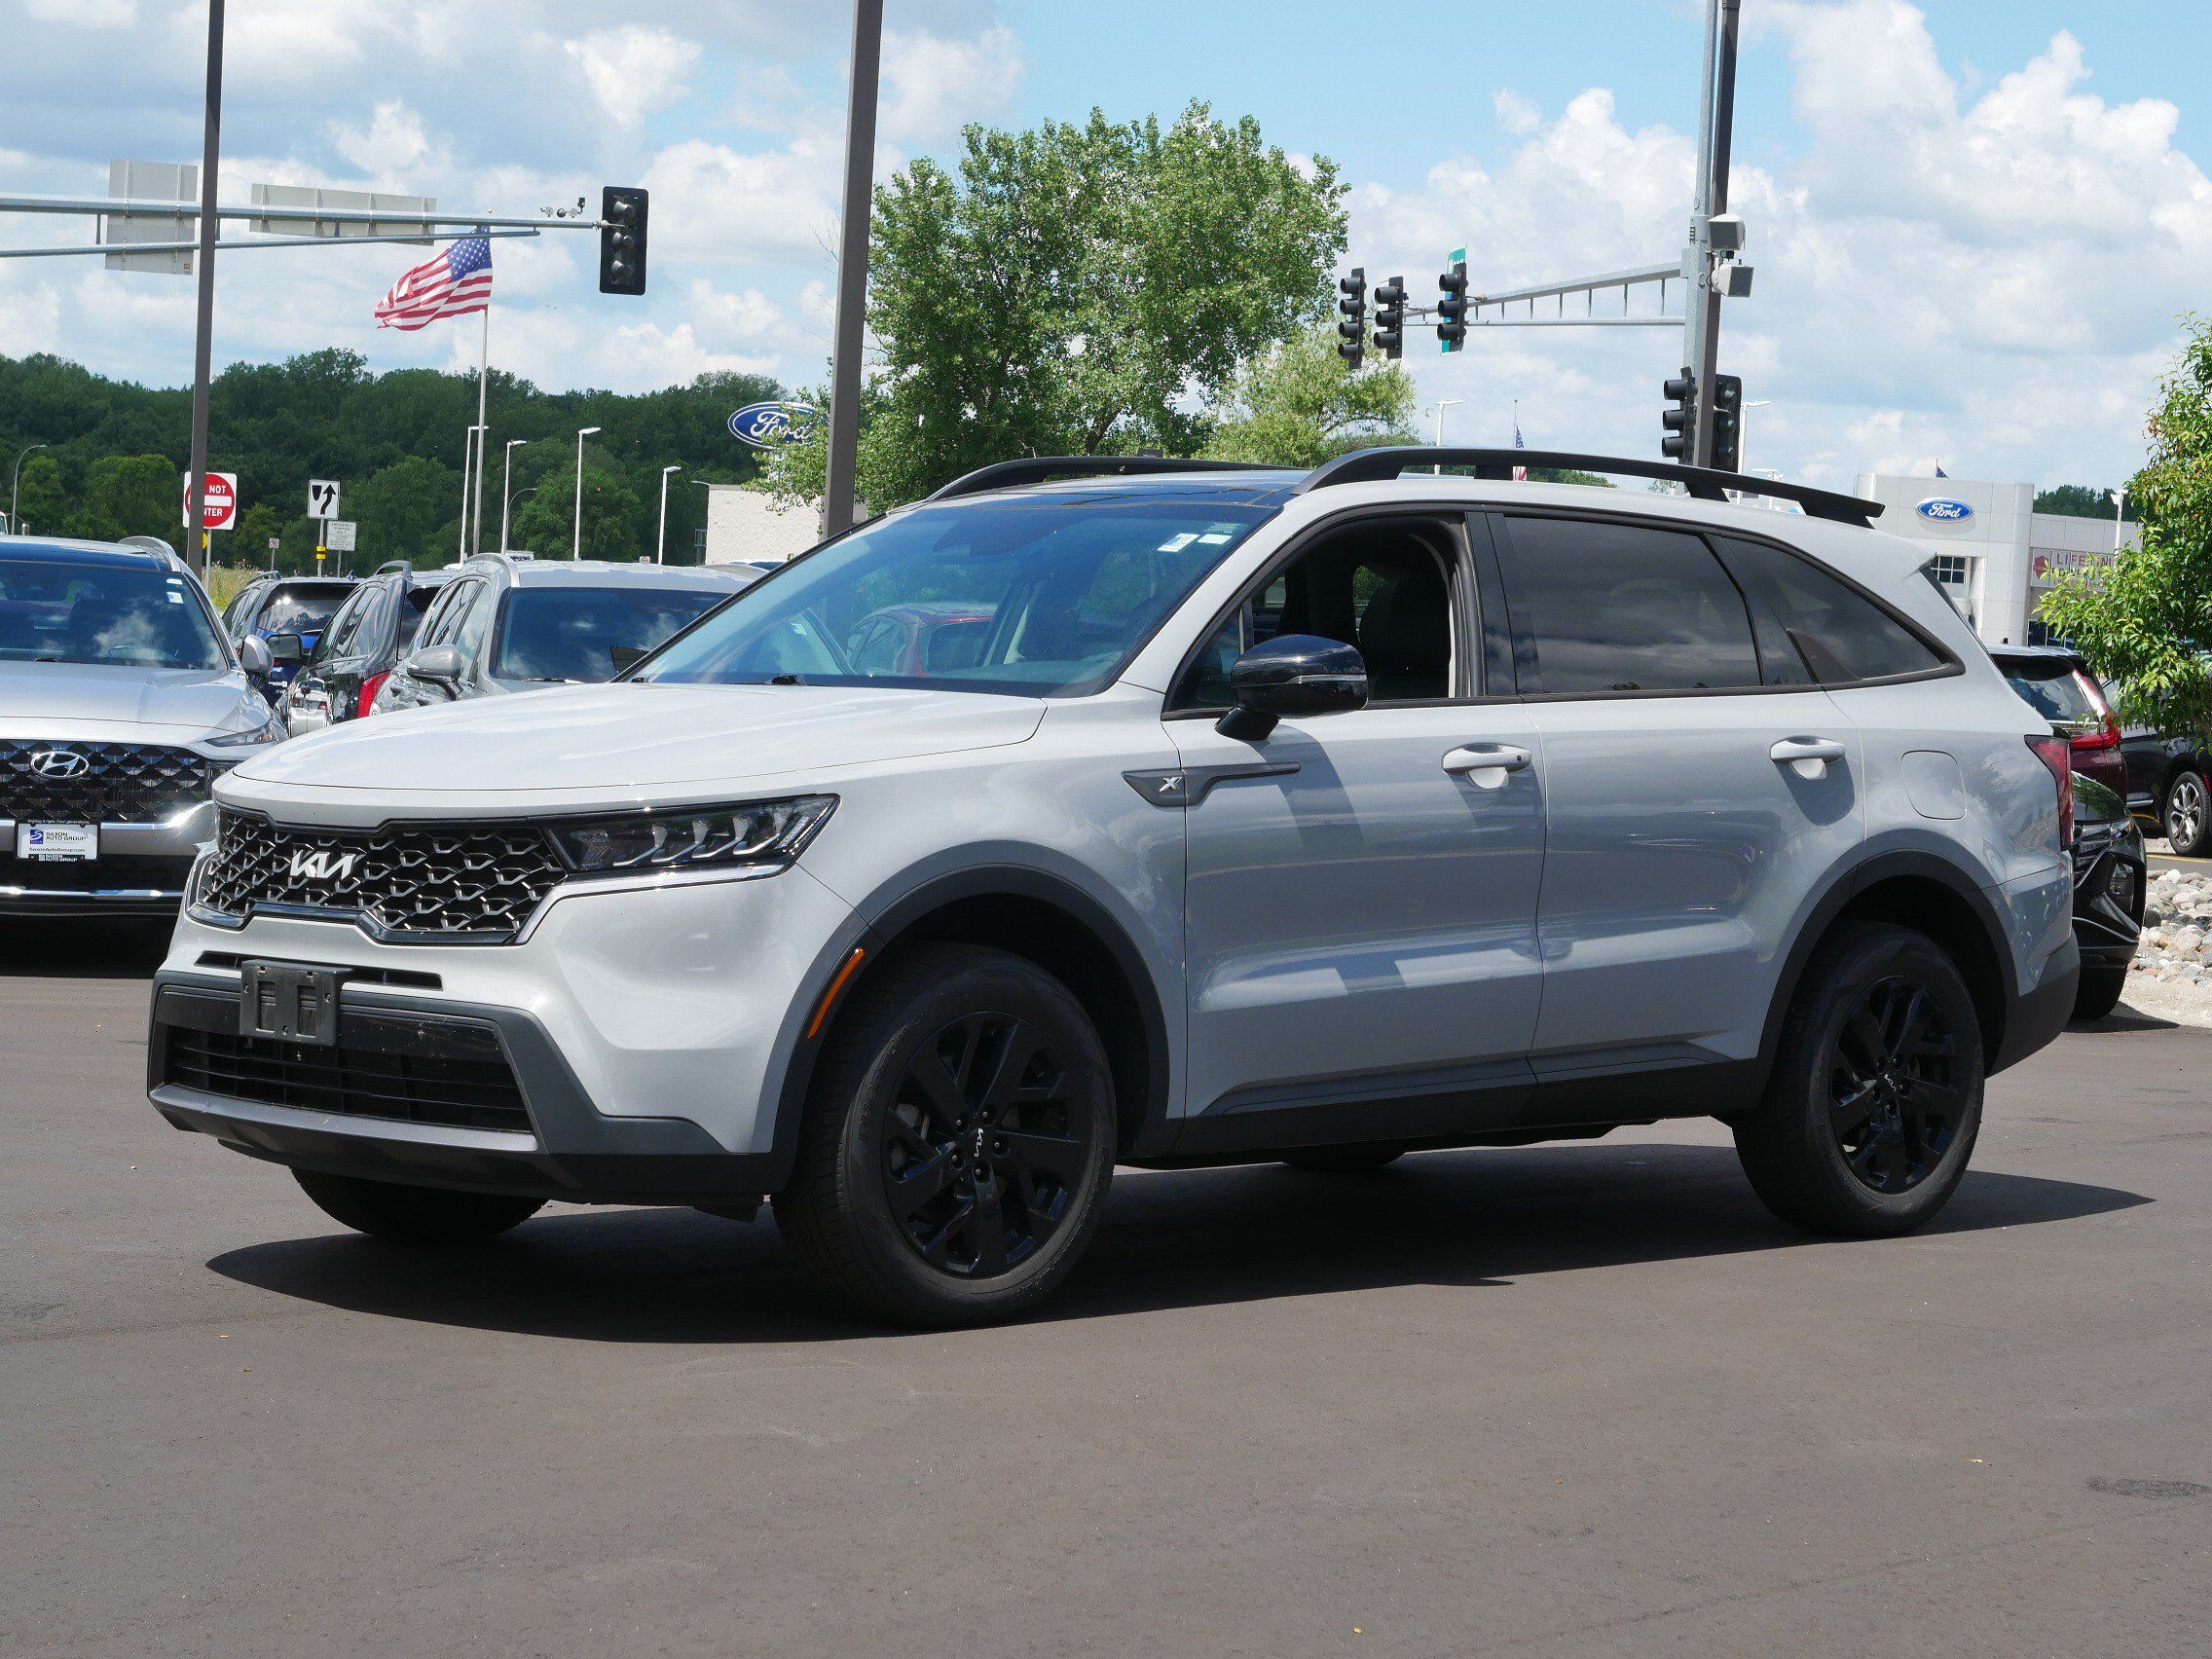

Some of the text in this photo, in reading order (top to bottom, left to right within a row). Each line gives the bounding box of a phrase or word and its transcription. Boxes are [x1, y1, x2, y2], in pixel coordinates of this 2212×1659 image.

[208, 485, 227, 495] NOT
[203, 507, 223, 517] TER
[1928, 502, 1962, 518] Ford
